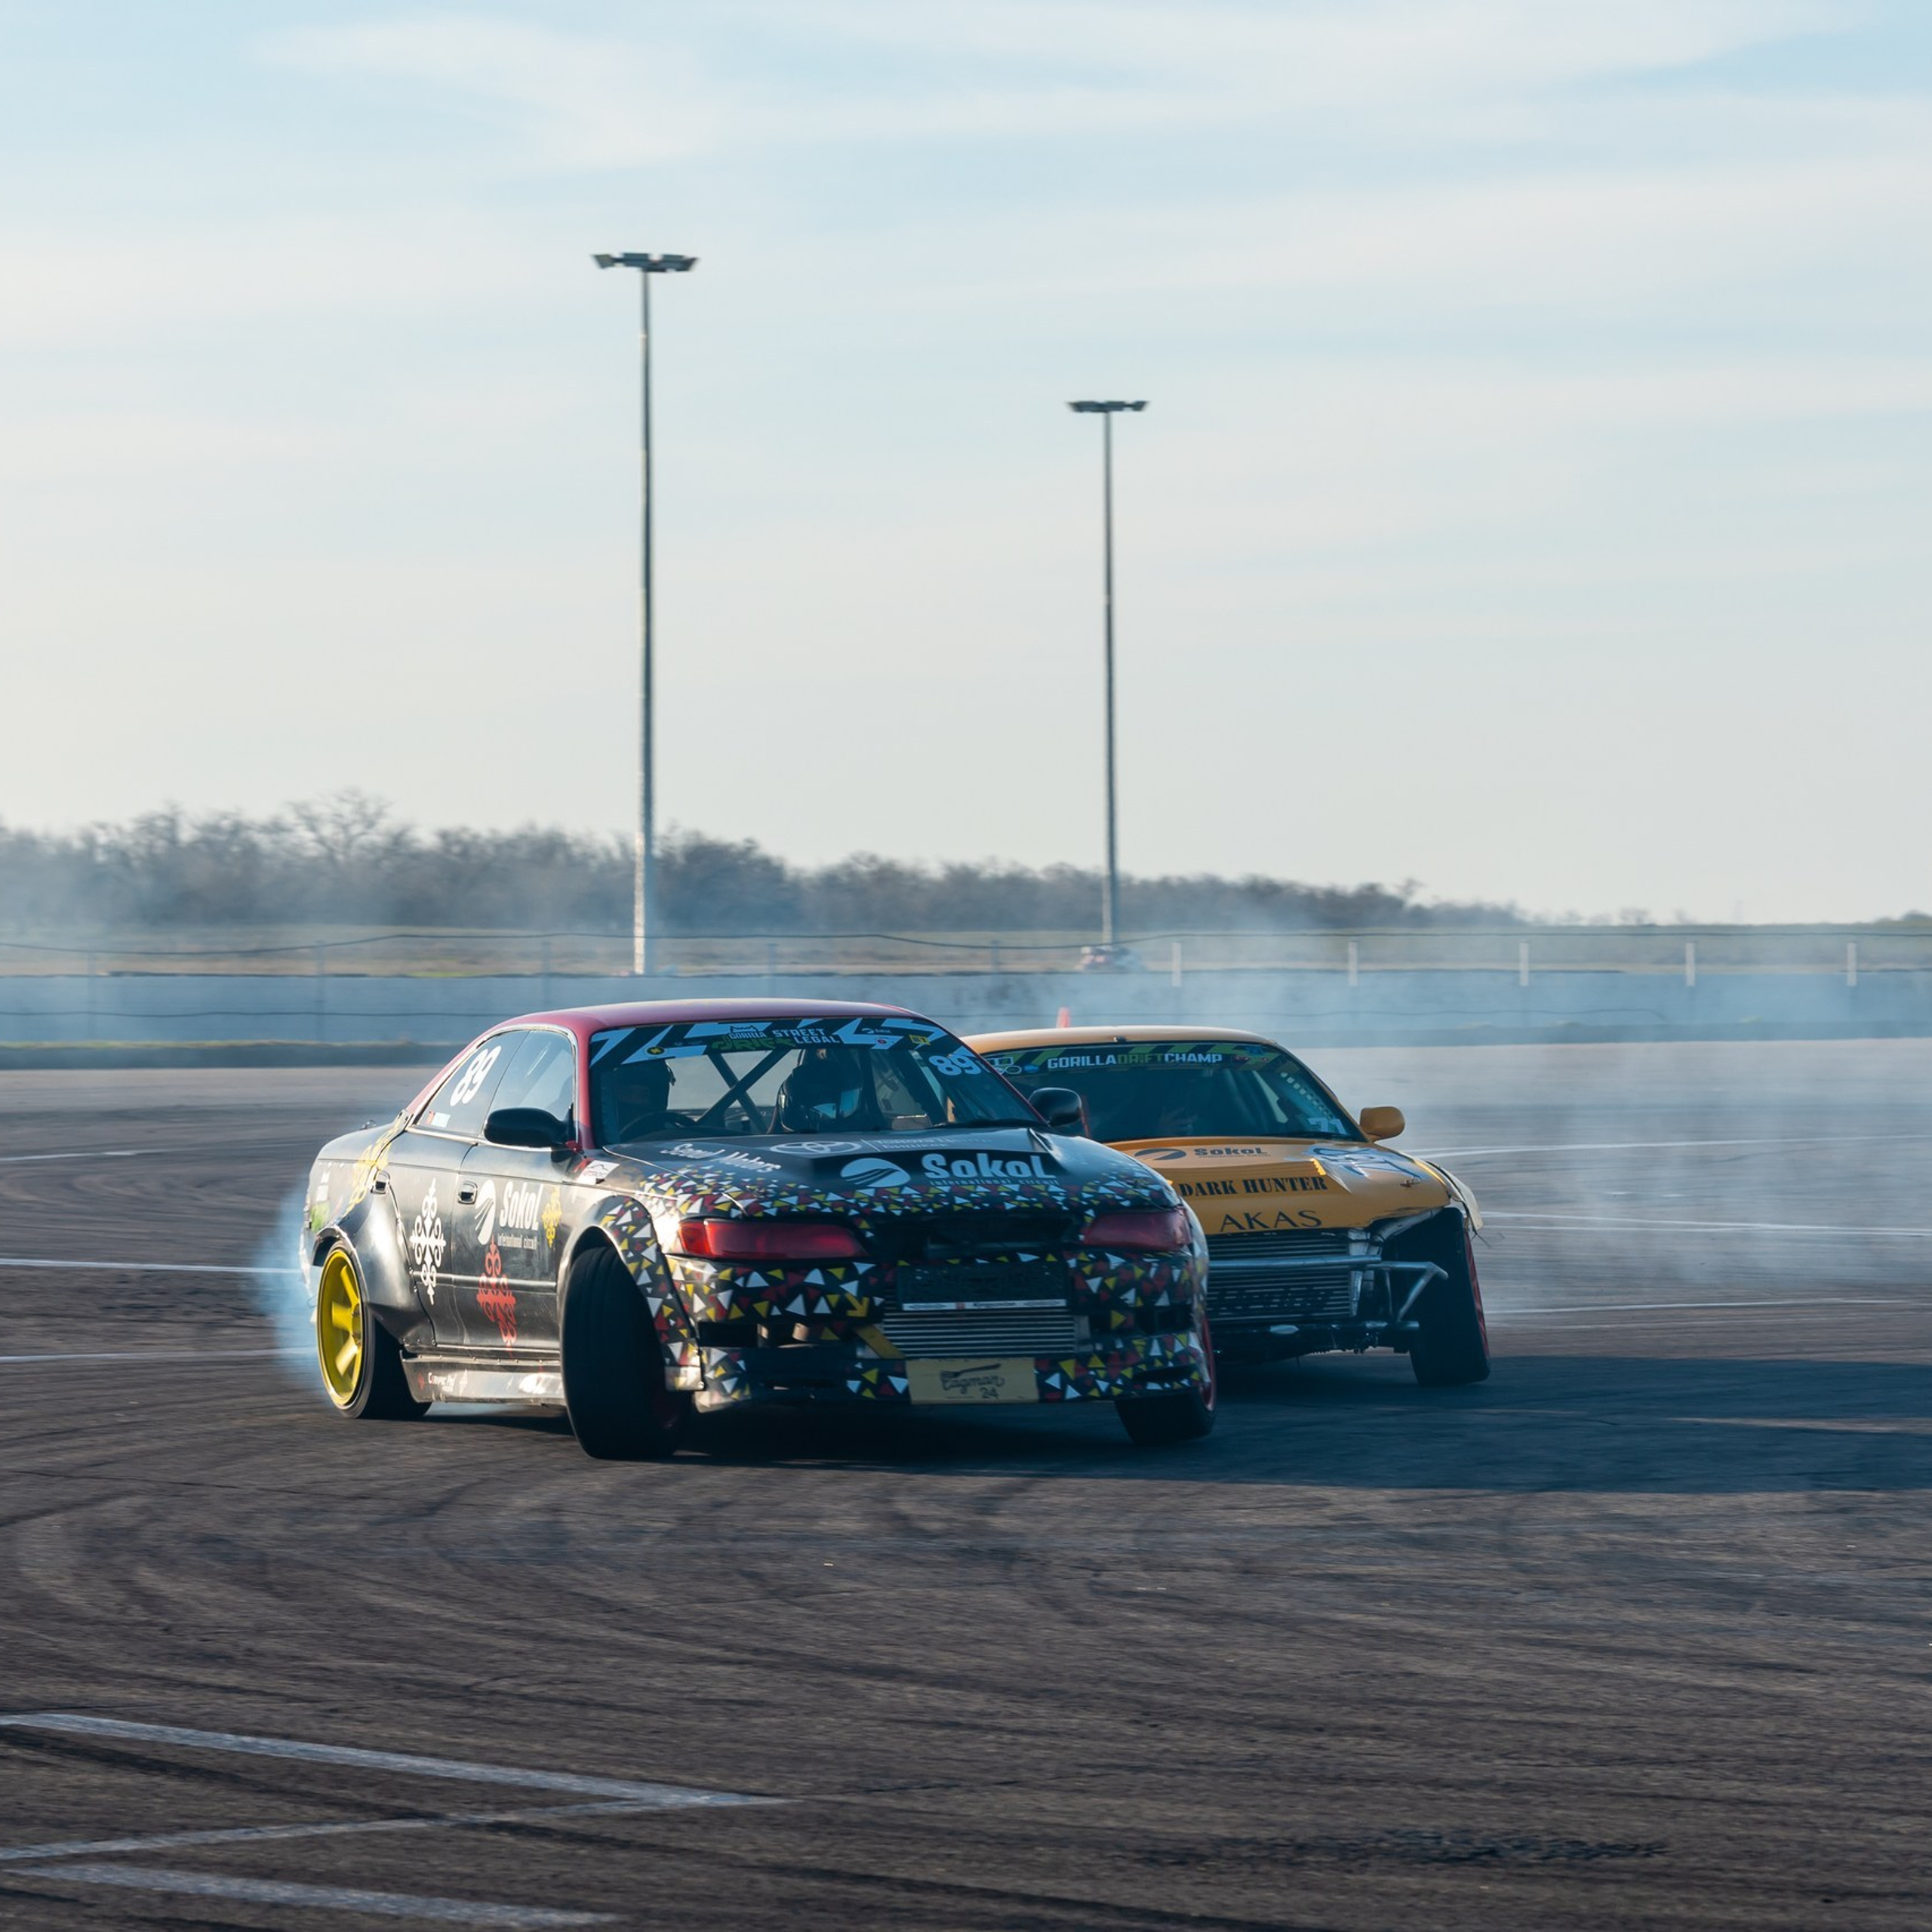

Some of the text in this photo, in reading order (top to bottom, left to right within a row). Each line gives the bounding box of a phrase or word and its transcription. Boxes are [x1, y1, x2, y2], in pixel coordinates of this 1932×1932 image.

[772, 1028, 826, 1038] STREET
[795, 1036, 840, 1044] LEGAL
[928, 1054, 981, 1075] 89
[450, 1045, 501, 1106] 89
[1179, 1177, 1328, 1197] DARK HUNTER
[1220, 1210, 1323, 1232] AKAS
